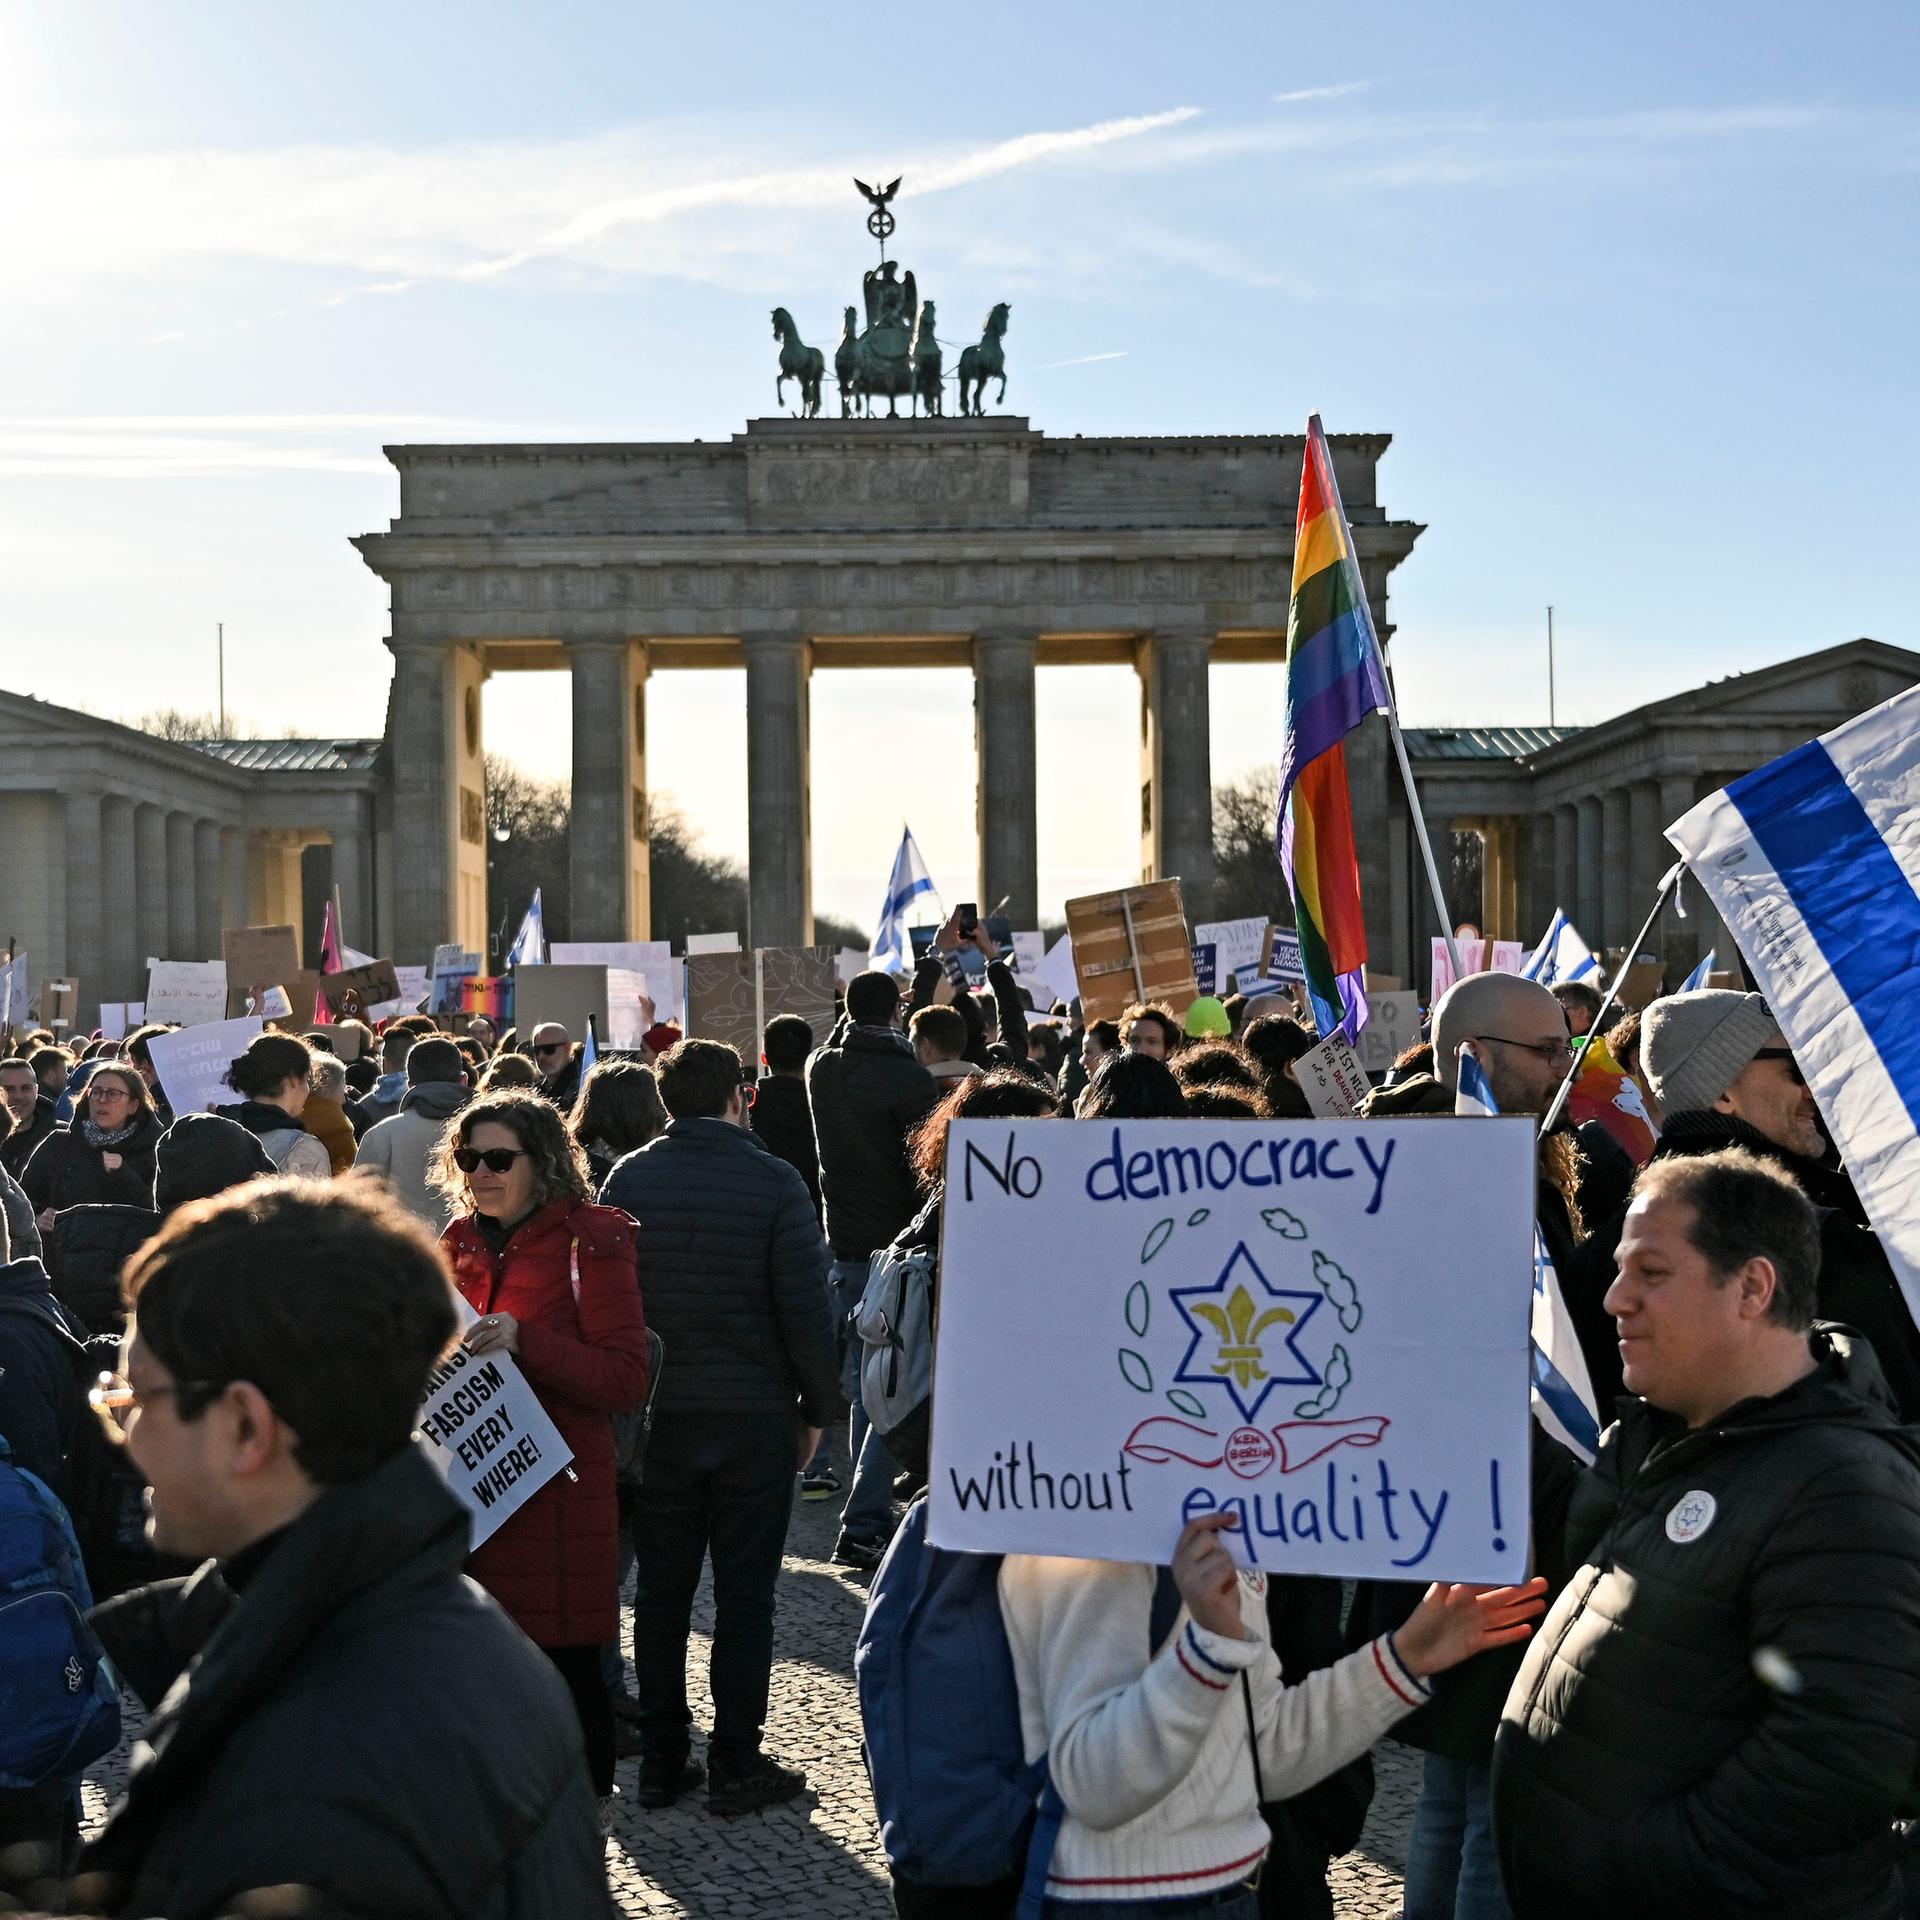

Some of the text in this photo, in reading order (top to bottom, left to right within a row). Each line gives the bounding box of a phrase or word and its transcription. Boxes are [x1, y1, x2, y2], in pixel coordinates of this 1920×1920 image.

[1321, 1045, 1335, 1068] FÜR
[1333, 1069, 1356, 1109] DEMOKR
[1331, 1036, 1344, 1051] ES
[1339, 1050, 1355, 1072] IST
[966, 1126, 1396, 1214] No democracy
[420, 1361, 505, 1447] FASCISM
[456, 1403, 514, 1472] EVERY
[472, 1433, 542, 1509] WHERE!
[950, 1440, 1133, 1511] without
[1181, 1459, 1448, 1567] equality
